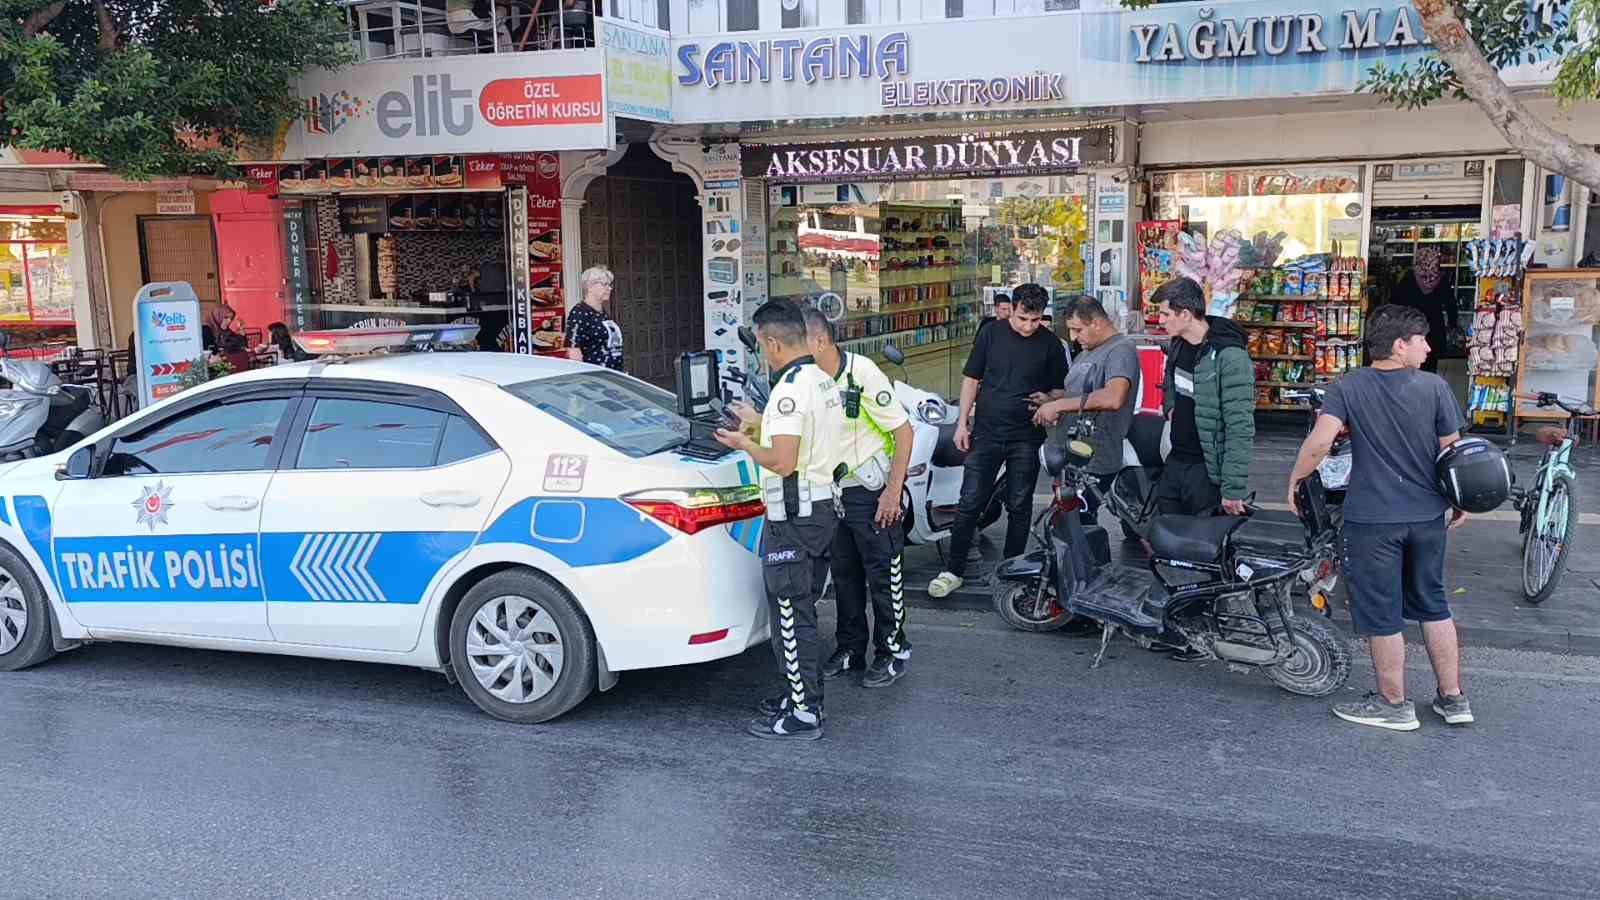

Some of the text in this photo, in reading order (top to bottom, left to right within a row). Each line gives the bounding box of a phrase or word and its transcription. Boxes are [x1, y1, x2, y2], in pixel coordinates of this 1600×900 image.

[604, 25, 668, 57] SANTANA
[1130, 9, 1328, 63] YAĞMUR
[677, 31, 911, 89] SANTANA
[376, 73, 474, 138] elit
[523, 80, 560, 98] ÖZEL
[879, 69, 1064, 108] ELEKTRONİK
[486, 101, 549, 121] ÖĞRETİM
[551, 101, 601, 118] KURSU
[767, 134, 1082, 177] AKSESUAR DÜNYASI
[551, 457, 582, 476] 112
[61, 543, 259, 591] TRAFİK POLİSİ
